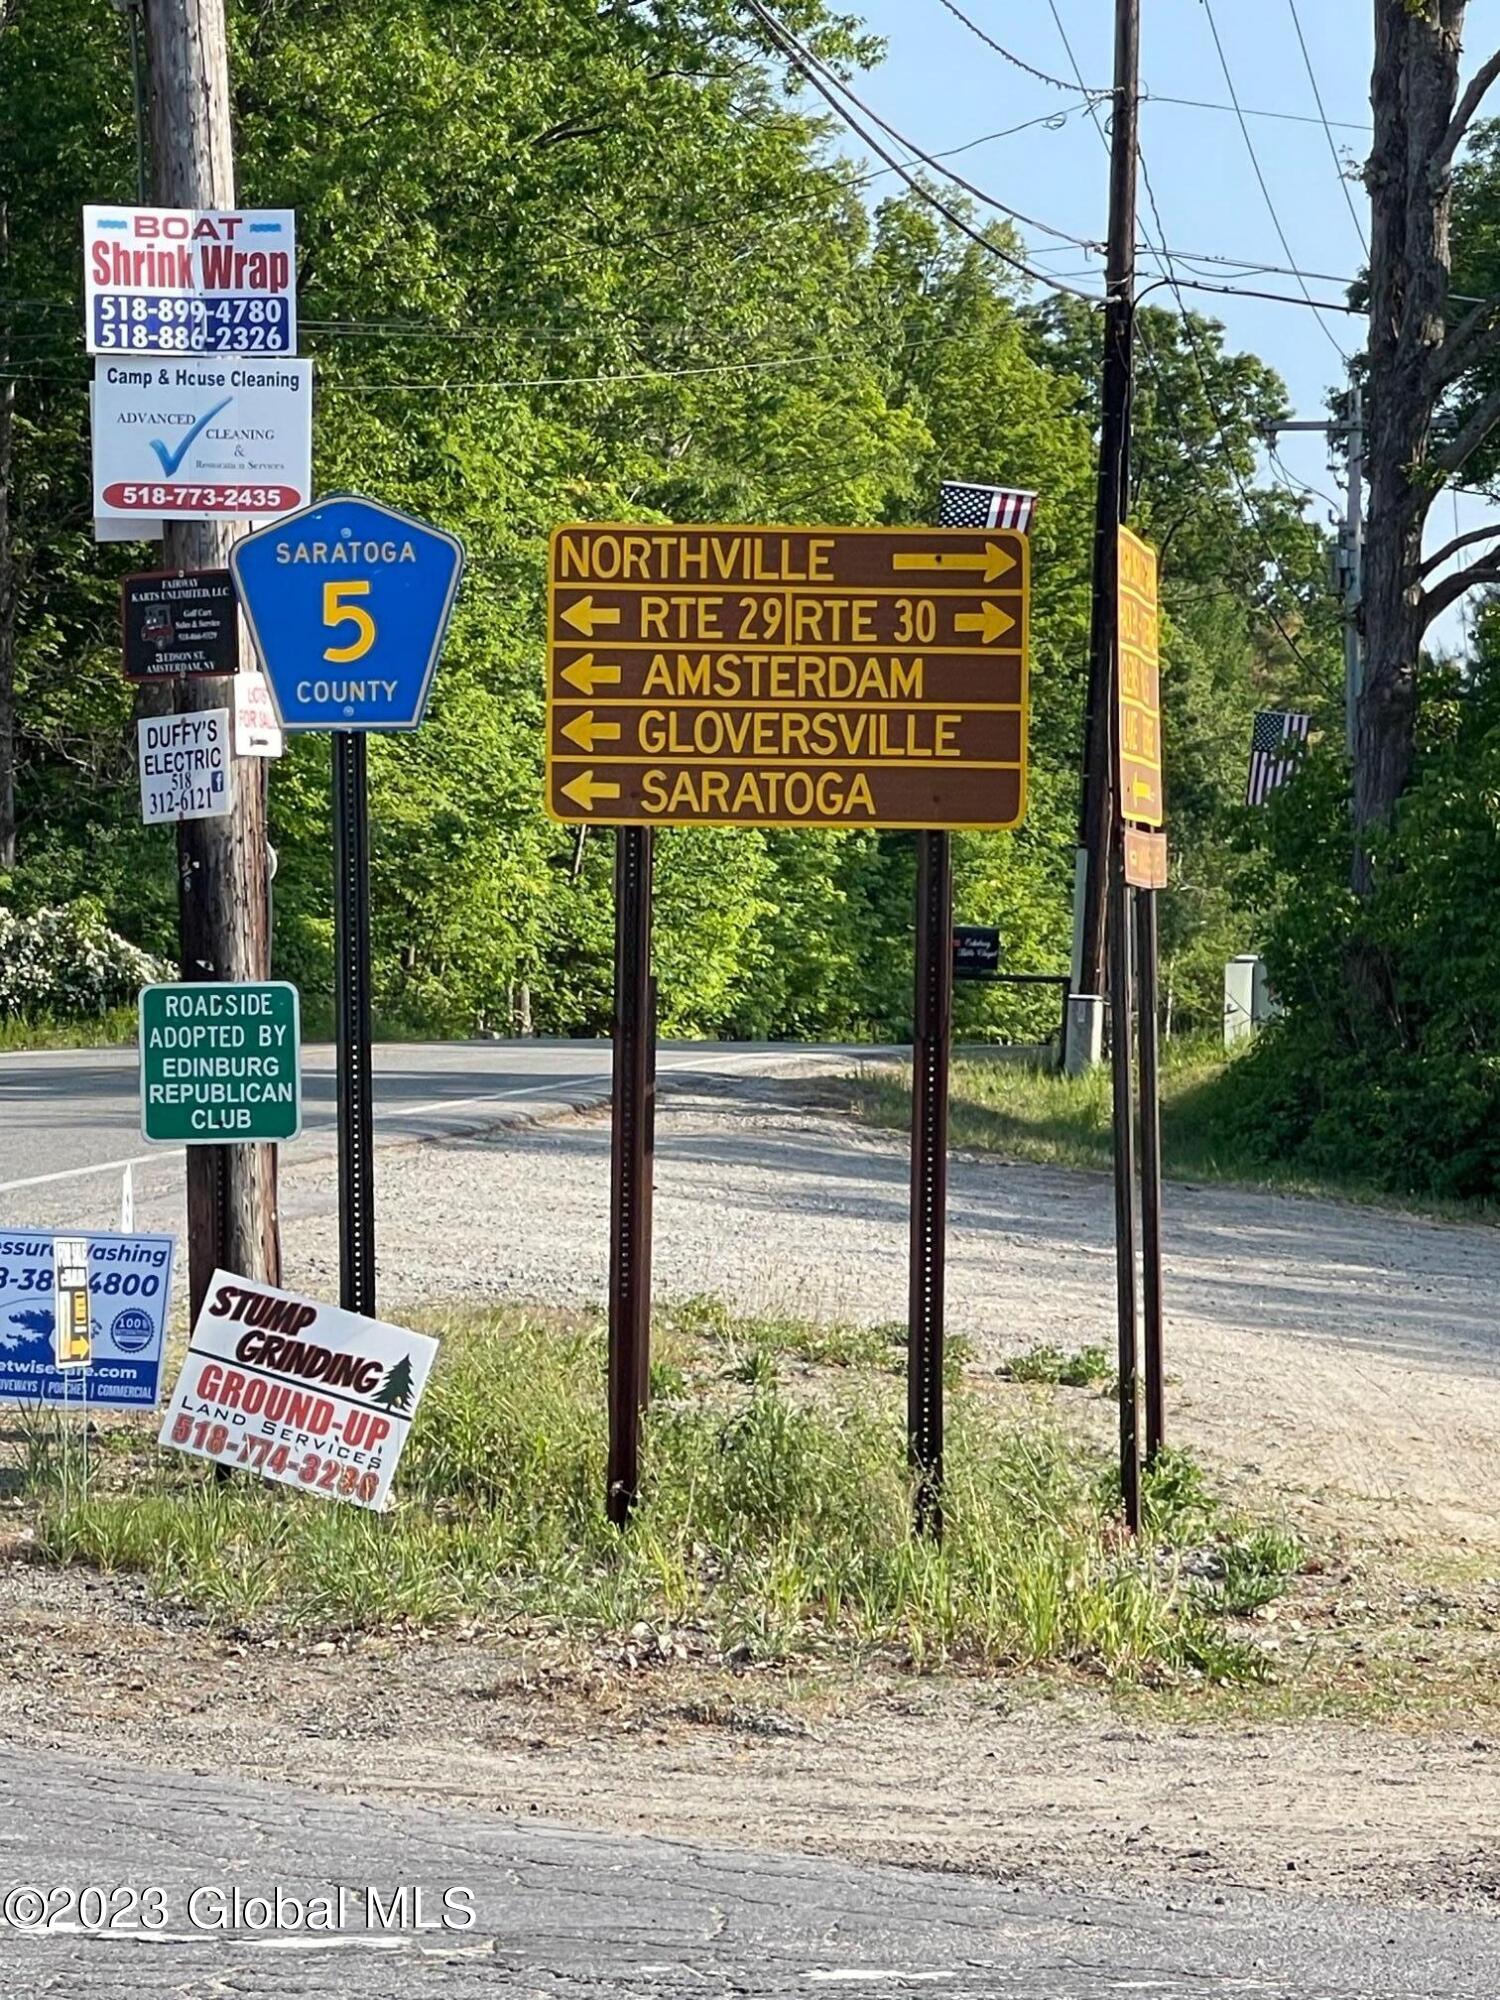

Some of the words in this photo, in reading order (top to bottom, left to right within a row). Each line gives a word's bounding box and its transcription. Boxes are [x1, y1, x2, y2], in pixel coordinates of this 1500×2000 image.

[134, 216, 243, 240] BOAT
[92, 240, 195, 289] Shrink
[201, 245, 289, 294] Wrap
[100, 297, 282, 323] 518-899-4780
[100, 324, 283, 350] 518-886-2326
[107, 367, 152, 388] Camp
[158, 369, 170, 385] &
[175, 369, 225, 387] House
[231, 370, 300, 392] Cleaning
[117, 412, 196, 425] ADVANCED
[205, 428, 275, 440] CLEANING
[234, 445, 245, 457] &
[123, 487, 281, 506] 518-773-2435
[276, 541, 417, 564] SARATOGA
[560, 535, 835, 581] NORTHVILLE
[132, 593, 160, 602] KARTS
[212, 587, 230, 596] LLC
[162, 579, 198, 589] FAIRWAY
[323, 580, 377, 663] 5
[640, 596, 723, 639] RTE
[738, 597, 783, 640] 29
[795, 599, 878, 642] RTE
[893, 599, 936, 643] 30
[155, 653, 163, 663] 3
[642, 653, 923, 699] AMSTERDAM
[296, 680, 398, 703] COUNTY
[147, 719, 217, 749] DUFFY'S
[638, 710, 962, 757] GLOVERSVILLE
[144, 747, 221, 776] ELECTRIC
[171, 772, 192, 791] 518
[640, 769, 876, 816] SARATOGA
[150, 787, 212, 815] 312-6121
[165, 993, 274, 1017] ROADSIDE
[149, 1025, 245, 1049] ADOPTED
[258, 1024, 286, 1047] BY
[162, 1056, 279, 1078] EDINBURG
[149, 1082, 293, 1104] REPUBLICAN
[191, 1108, 251, 1130] CLUB
[0, 1241, 54, 1257] ssur
[87, 1244, 167, 1267] ashing
[208, 1285, 317, 1336] STUMP
[235, 1330, 384, 1394] GRINDING
[97, 1384, 153, 1399] COMMERCIAL
[196, 1364, 391, 1452] GROUND-UP
[181, 1395, 247, 1426] LAND
[261, 1421, 382, 1470] SERVICES
